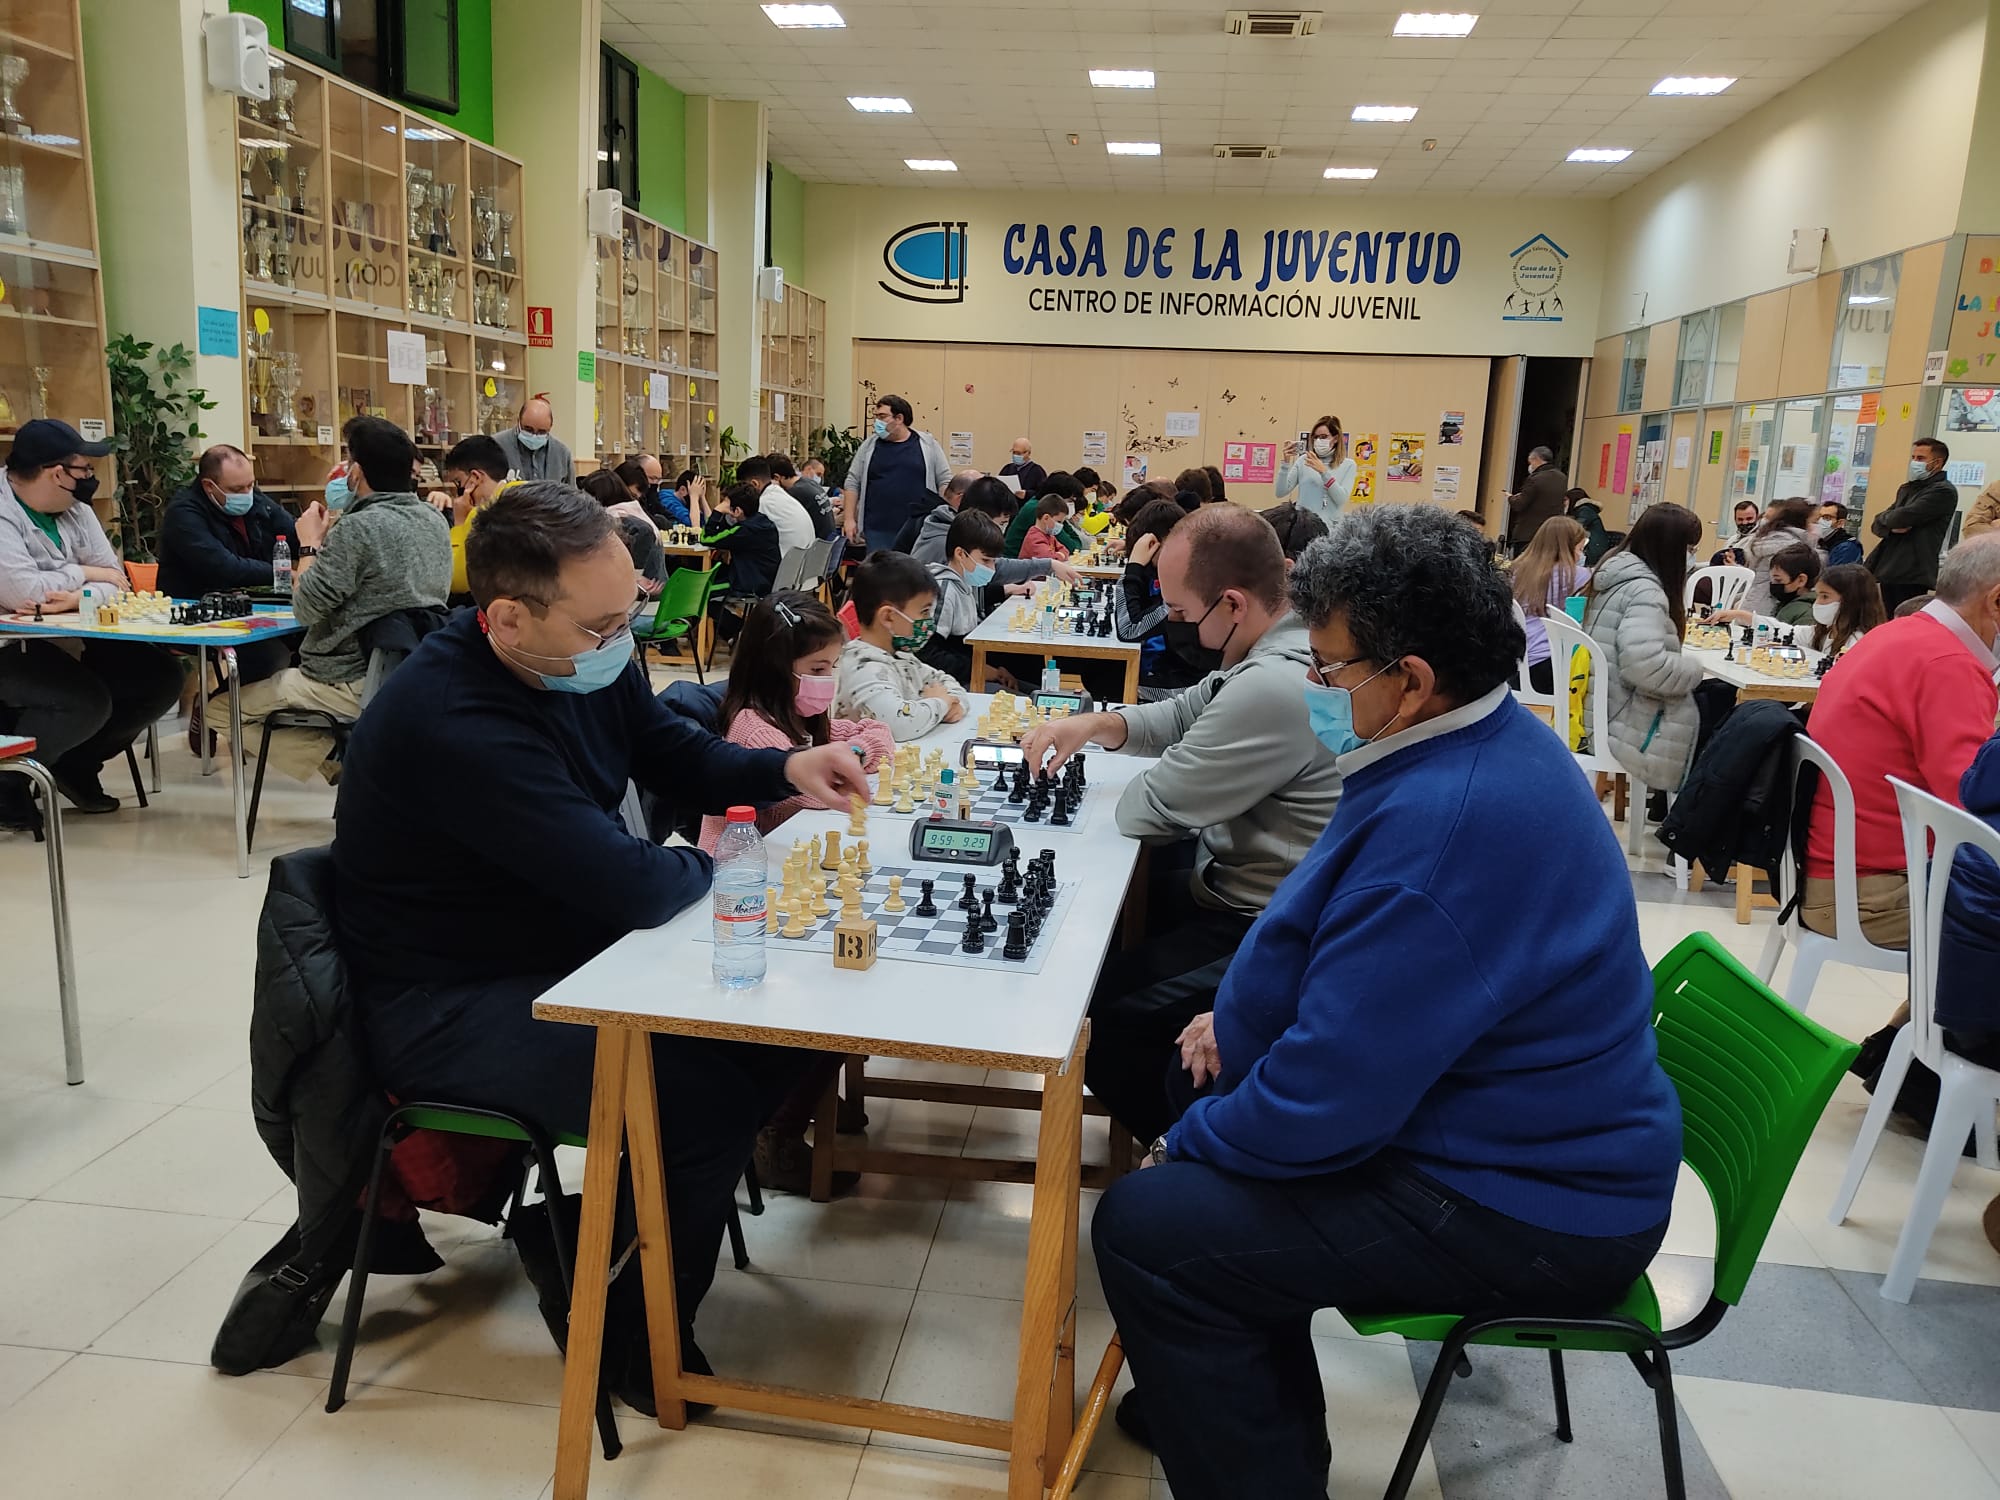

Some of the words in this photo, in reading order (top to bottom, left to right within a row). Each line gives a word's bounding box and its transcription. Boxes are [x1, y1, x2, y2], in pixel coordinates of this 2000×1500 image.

[1003, 223, 1108, 278] CASA
[1123, 226, 1176, 280] DE
[1192, 228, 1243, 281] LA
[1255, 229, 1461, 292] JUVENTUD
[1029, 288, 1117, 313] CENTRO
[1123, 291, 1153, 315] DE
[1160, 290, 1322, 319] INFORMACIÓN
[1328, 295, 1421, 321] JUVENIL
[1957, 293, 1982, 312] LA
